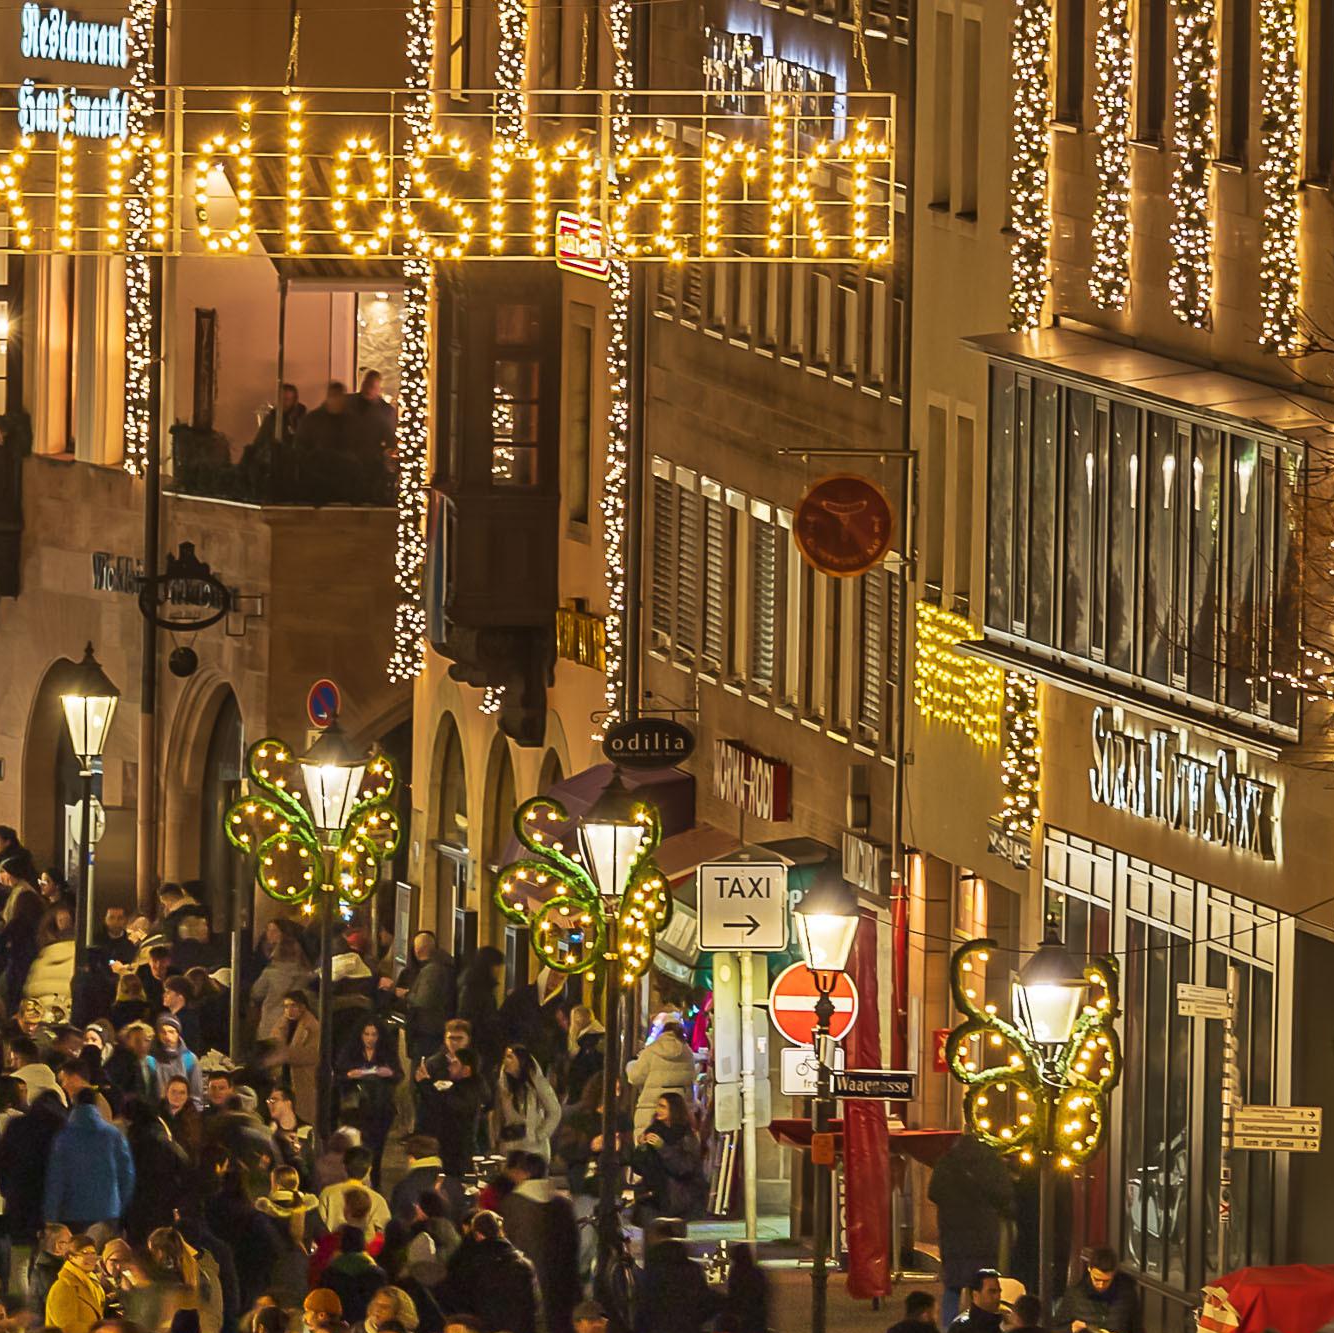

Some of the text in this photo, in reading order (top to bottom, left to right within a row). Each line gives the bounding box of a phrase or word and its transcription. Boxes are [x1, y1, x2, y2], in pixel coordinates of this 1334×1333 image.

[21, 2, 130, 68] Restaurant
[611, 732, 685, 751] odilia
[714, 876, 771, 899] TAXI
